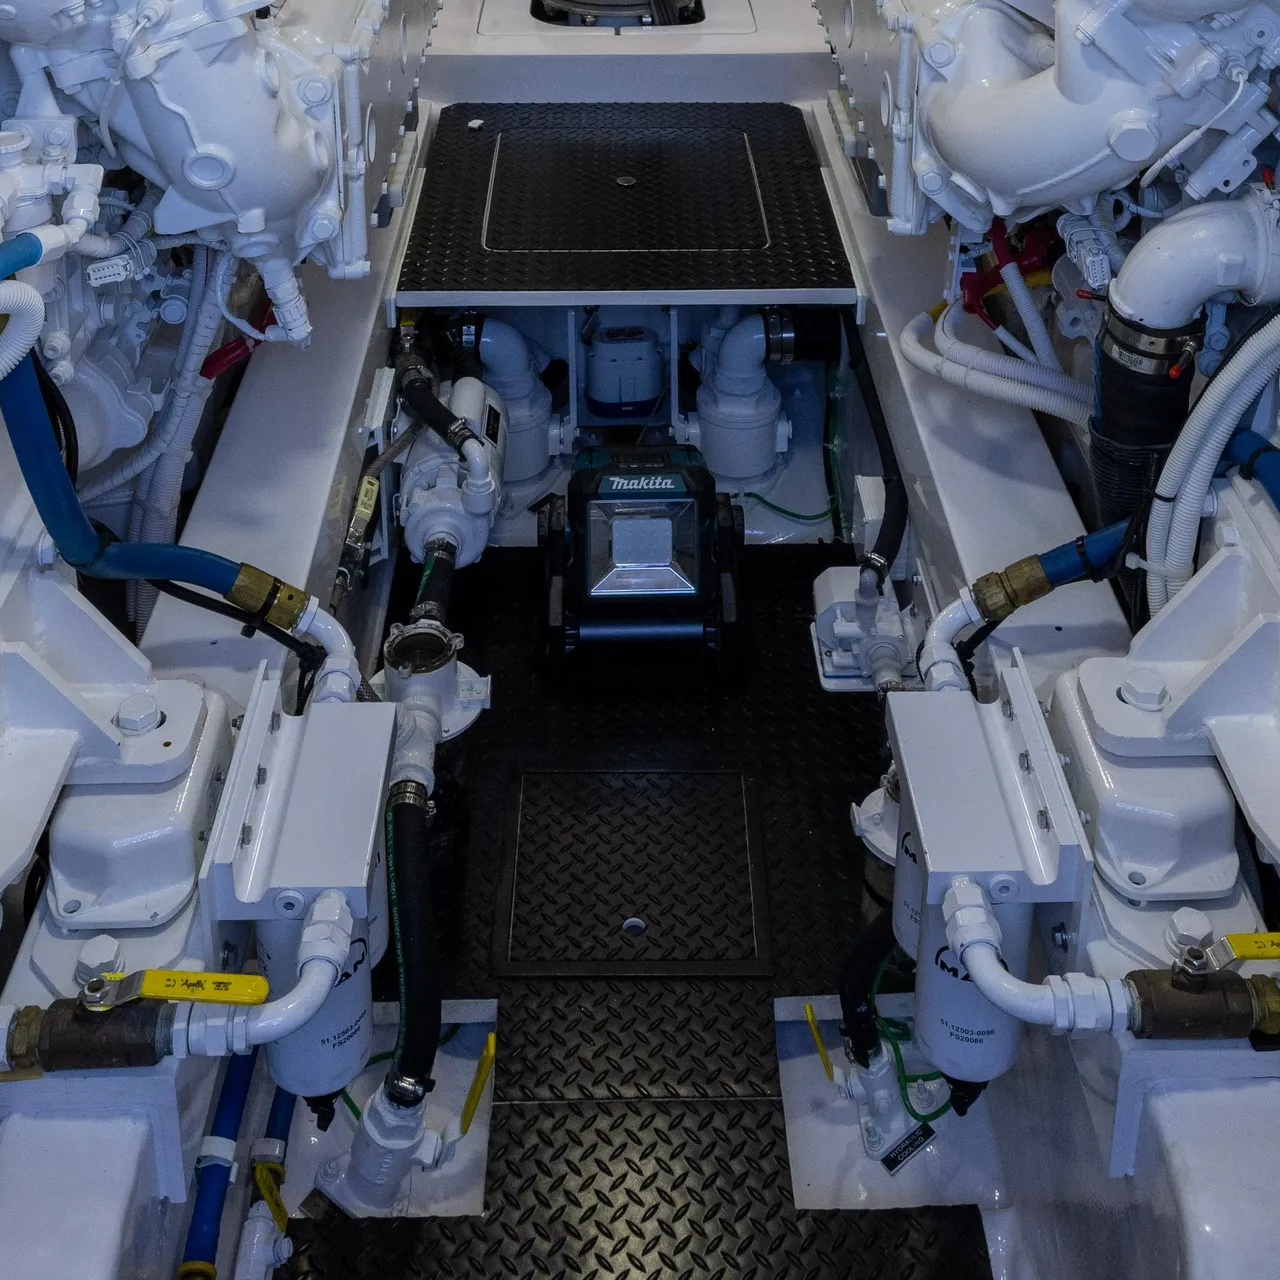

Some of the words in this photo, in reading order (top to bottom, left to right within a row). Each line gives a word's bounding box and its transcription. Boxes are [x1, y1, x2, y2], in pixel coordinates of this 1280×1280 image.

[949, 1031, 984, 1044] FS20086
[890, 1128, 923, 1158] HYDRAULIC
[897, 1136, 925, 1161] COOLING
